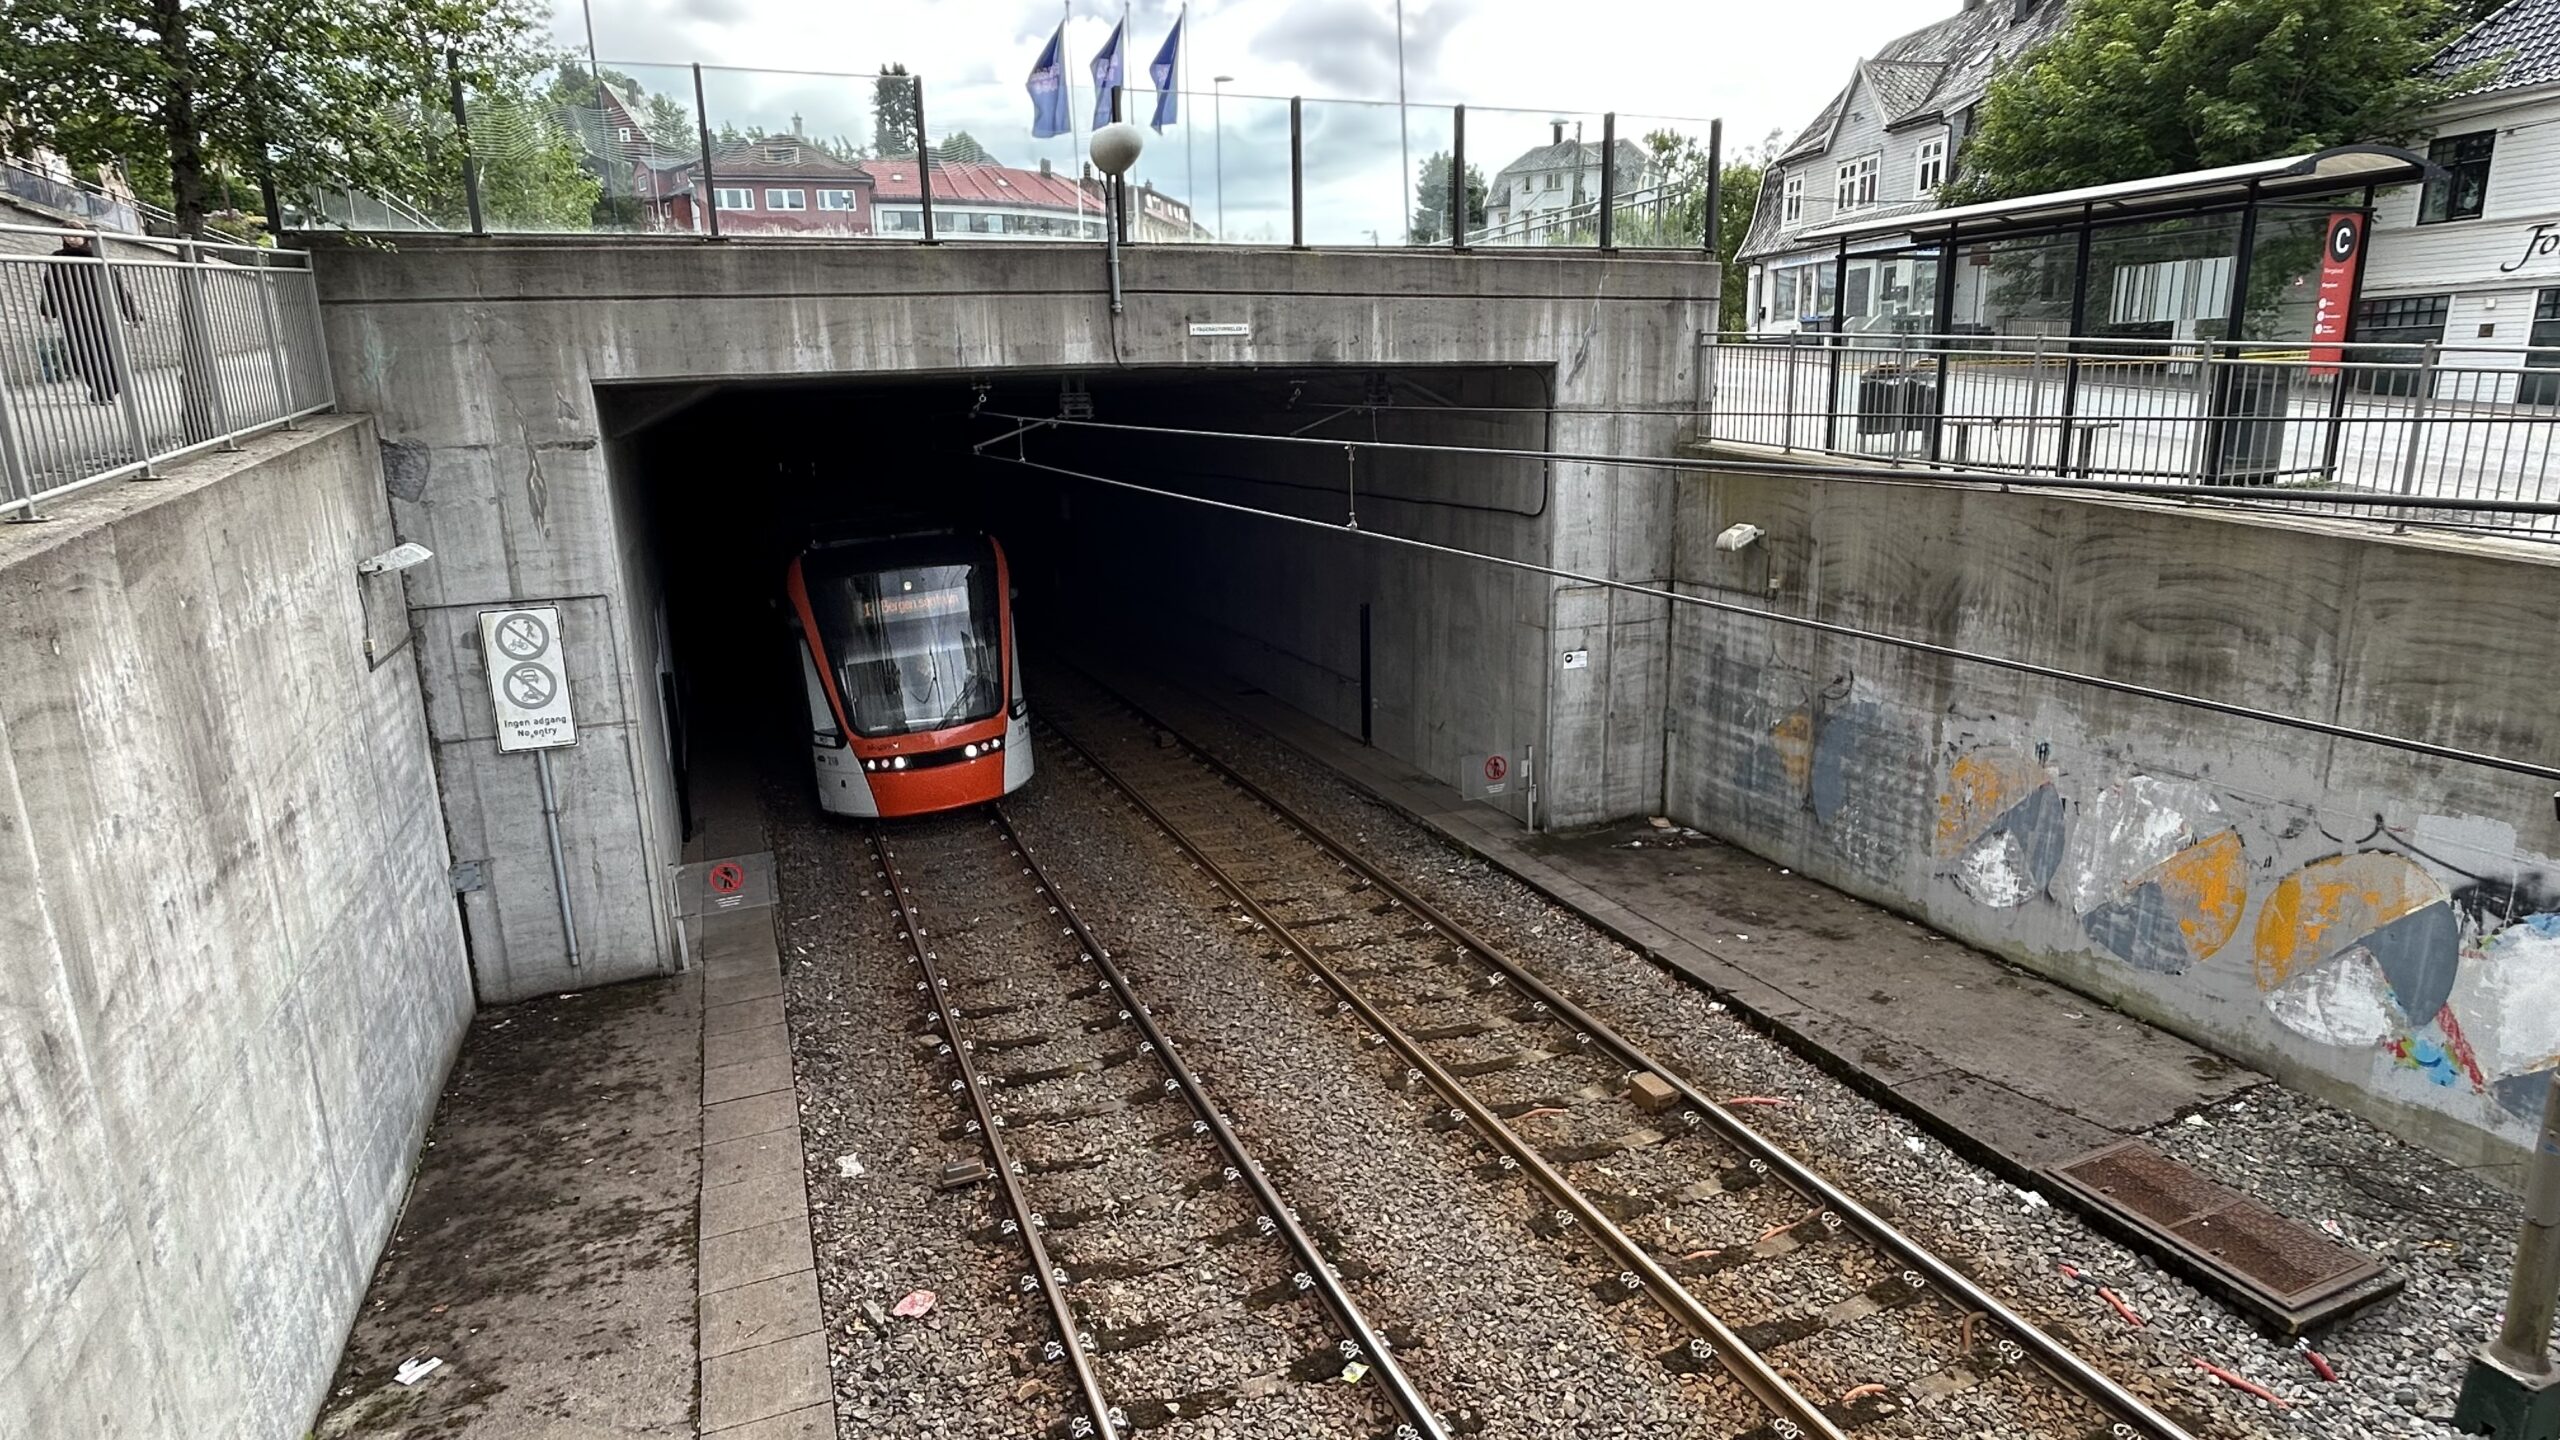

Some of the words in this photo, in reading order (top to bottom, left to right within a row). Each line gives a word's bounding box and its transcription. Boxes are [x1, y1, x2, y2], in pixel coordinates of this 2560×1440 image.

[2336, 227, 2351, 253] C
[2500, 223, 2560, 272] Fo
[504, 720, 530, 728] Ingen
[533, 717, 566, 725] adgang
[533, 728, 557, 736] entry
